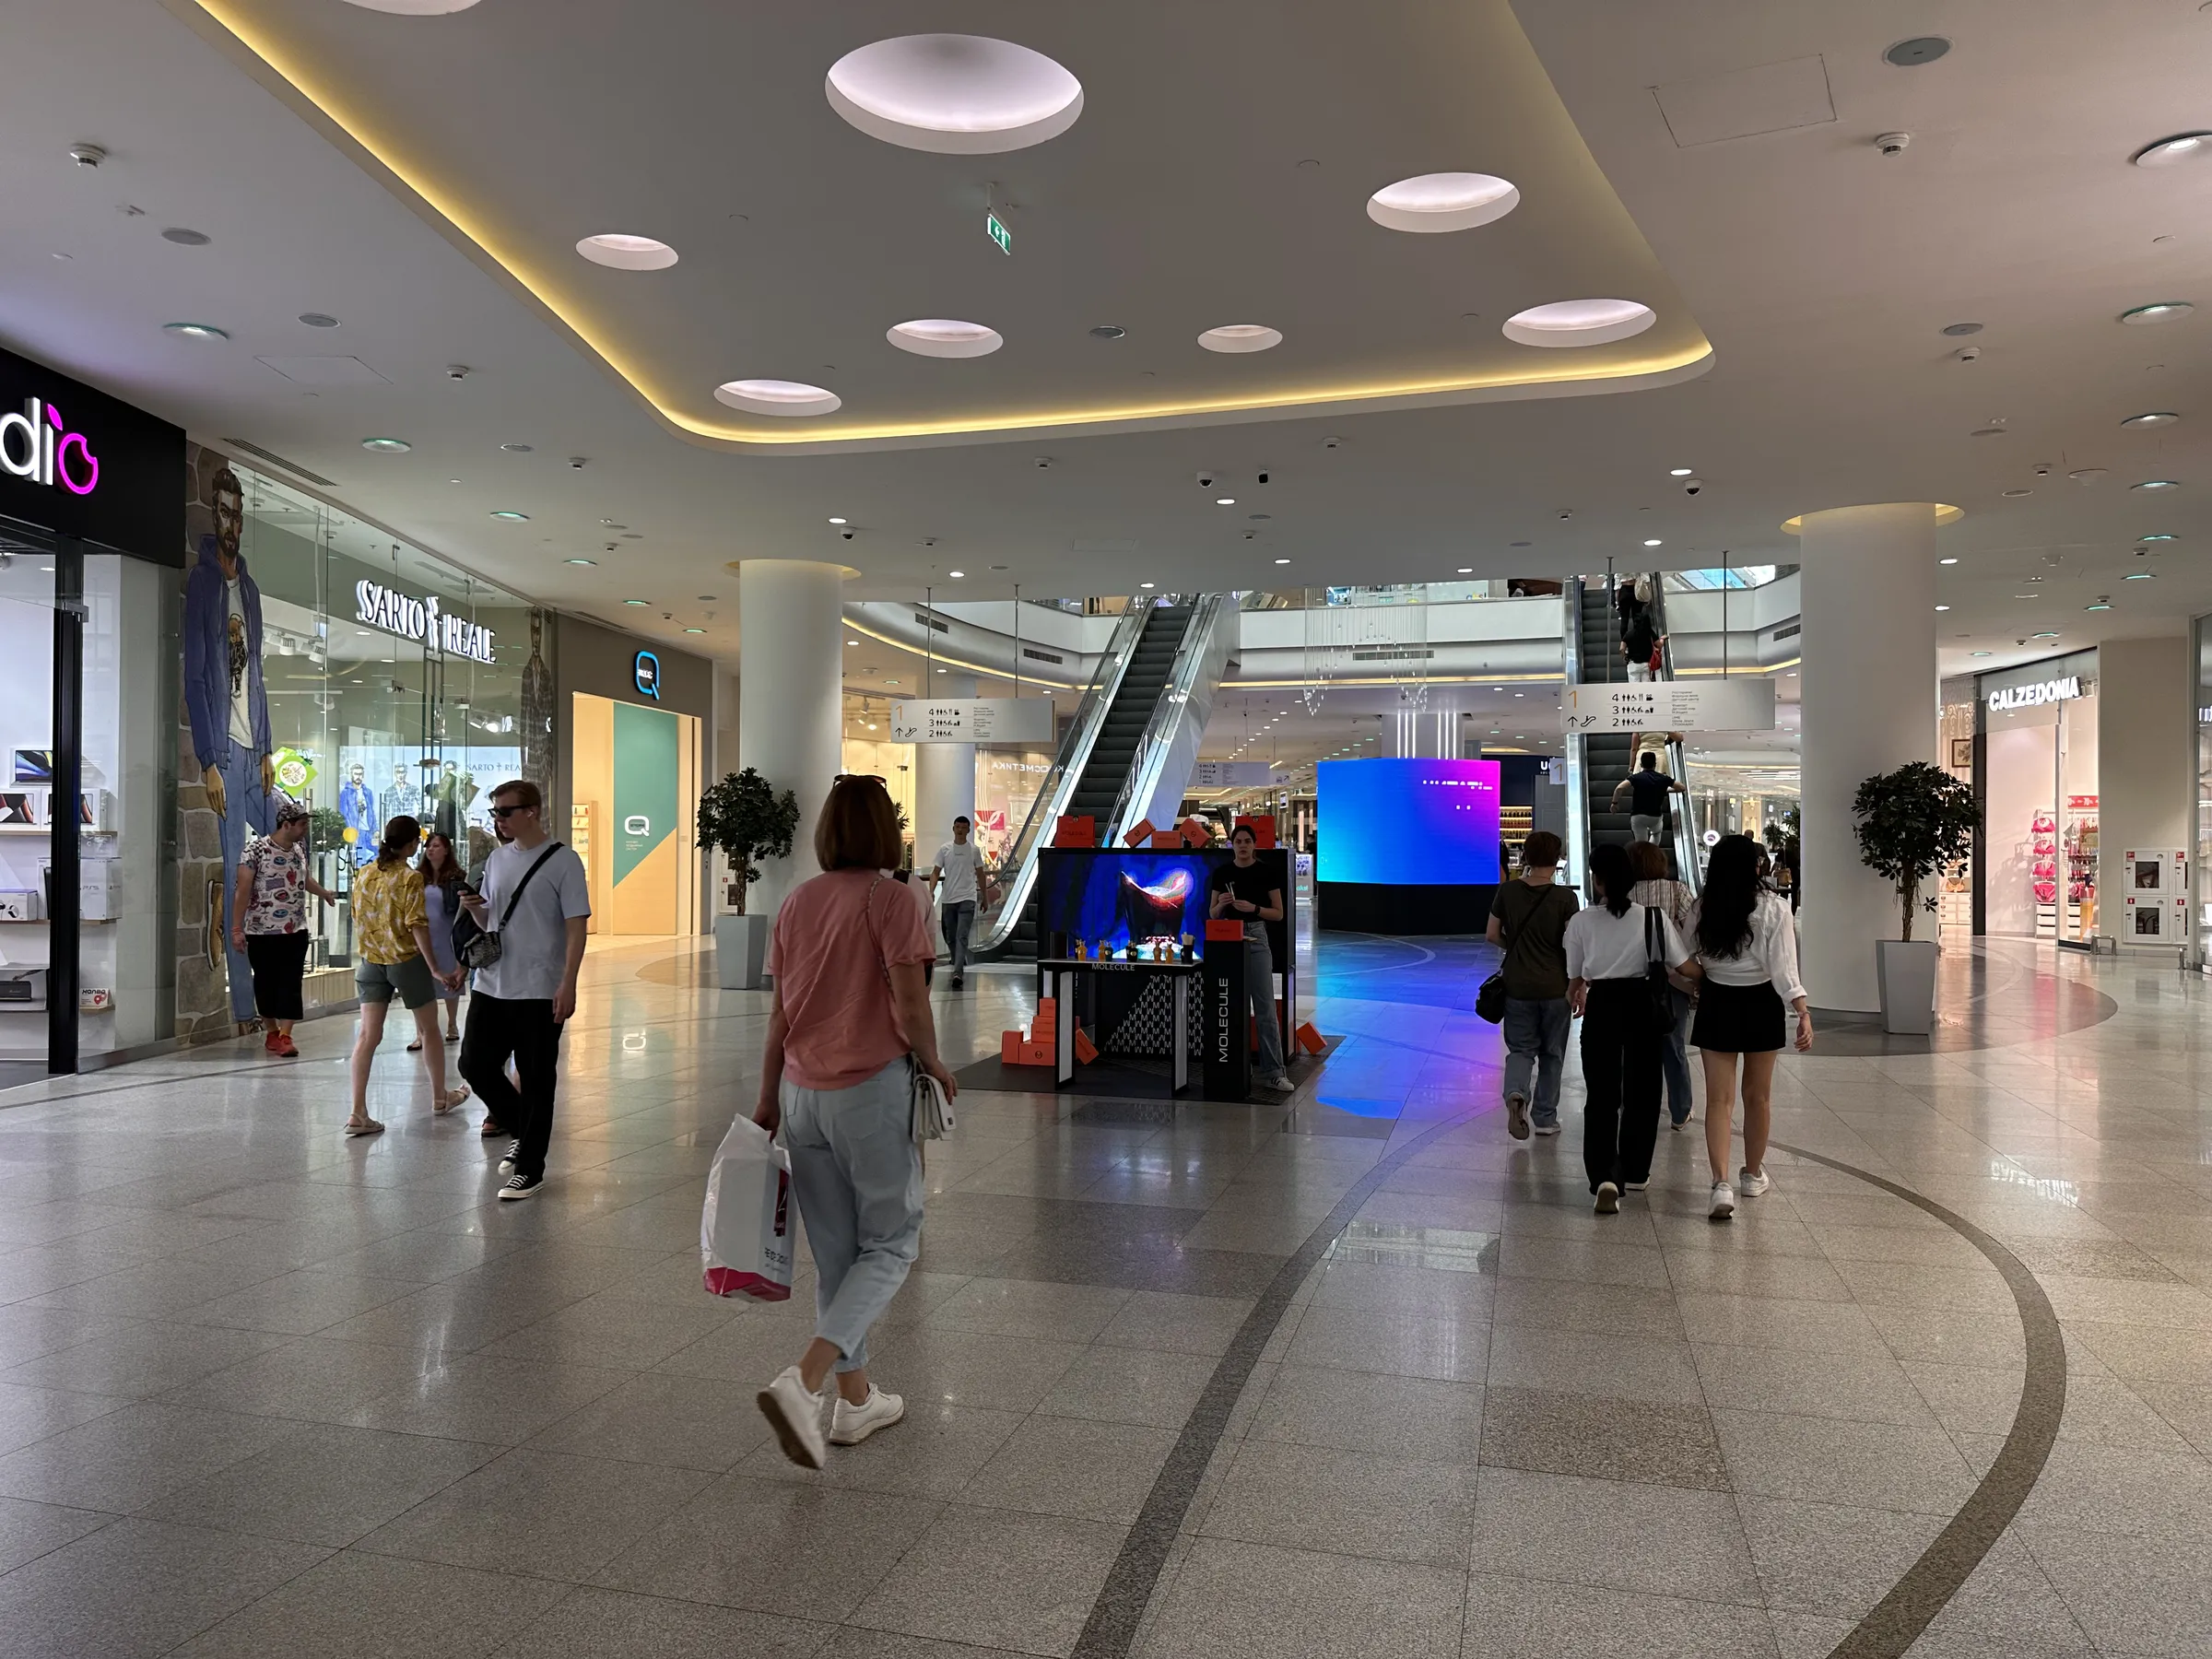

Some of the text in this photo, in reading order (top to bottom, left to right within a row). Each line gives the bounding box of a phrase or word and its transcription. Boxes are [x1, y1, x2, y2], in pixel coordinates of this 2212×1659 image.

[356, 580, 497, 664] SARTO REALE
[1569, 689, 1577, 709] 1
[1989, 676, 2082, 712] CALZEDONIA
[895, 705, 902, 721] 1
[1612, 706, 1619, 714] 3
[1612, 718, 1619, 726] 2
[467, 763, 495, 771] SARTO
[1554, 763, 1562, 782] 1
[1091, 963, 1135, 971] MOLECULE
[1218, 978, 1229, 1062] MOLECULE
